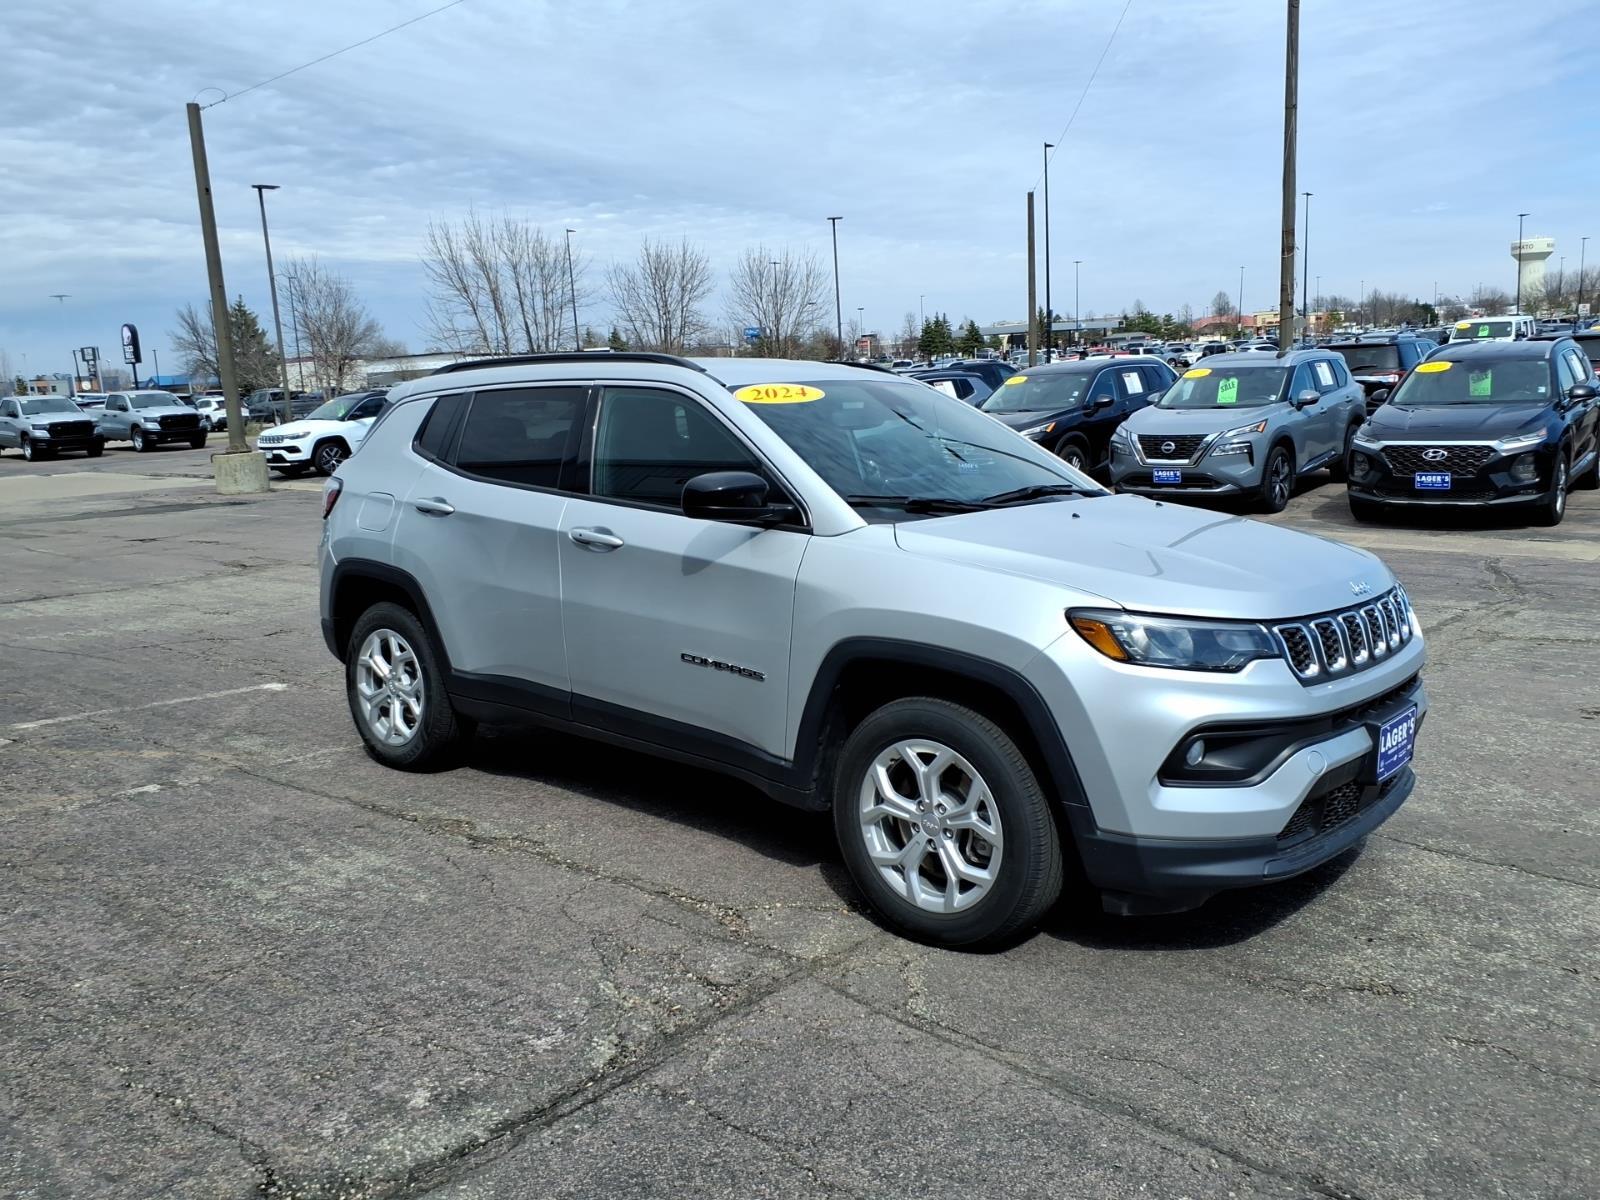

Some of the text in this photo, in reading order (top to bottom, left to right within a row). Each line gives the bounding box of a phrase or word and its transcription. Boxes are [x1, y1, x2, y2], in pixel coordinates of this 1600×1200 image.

[751, 387, 808, 401] 2024
[1220, 381, 1236, 393] SALE
[680, 653, 766, 682] COMPASS
[1380, 717, 1416, 753] LAGER'S
